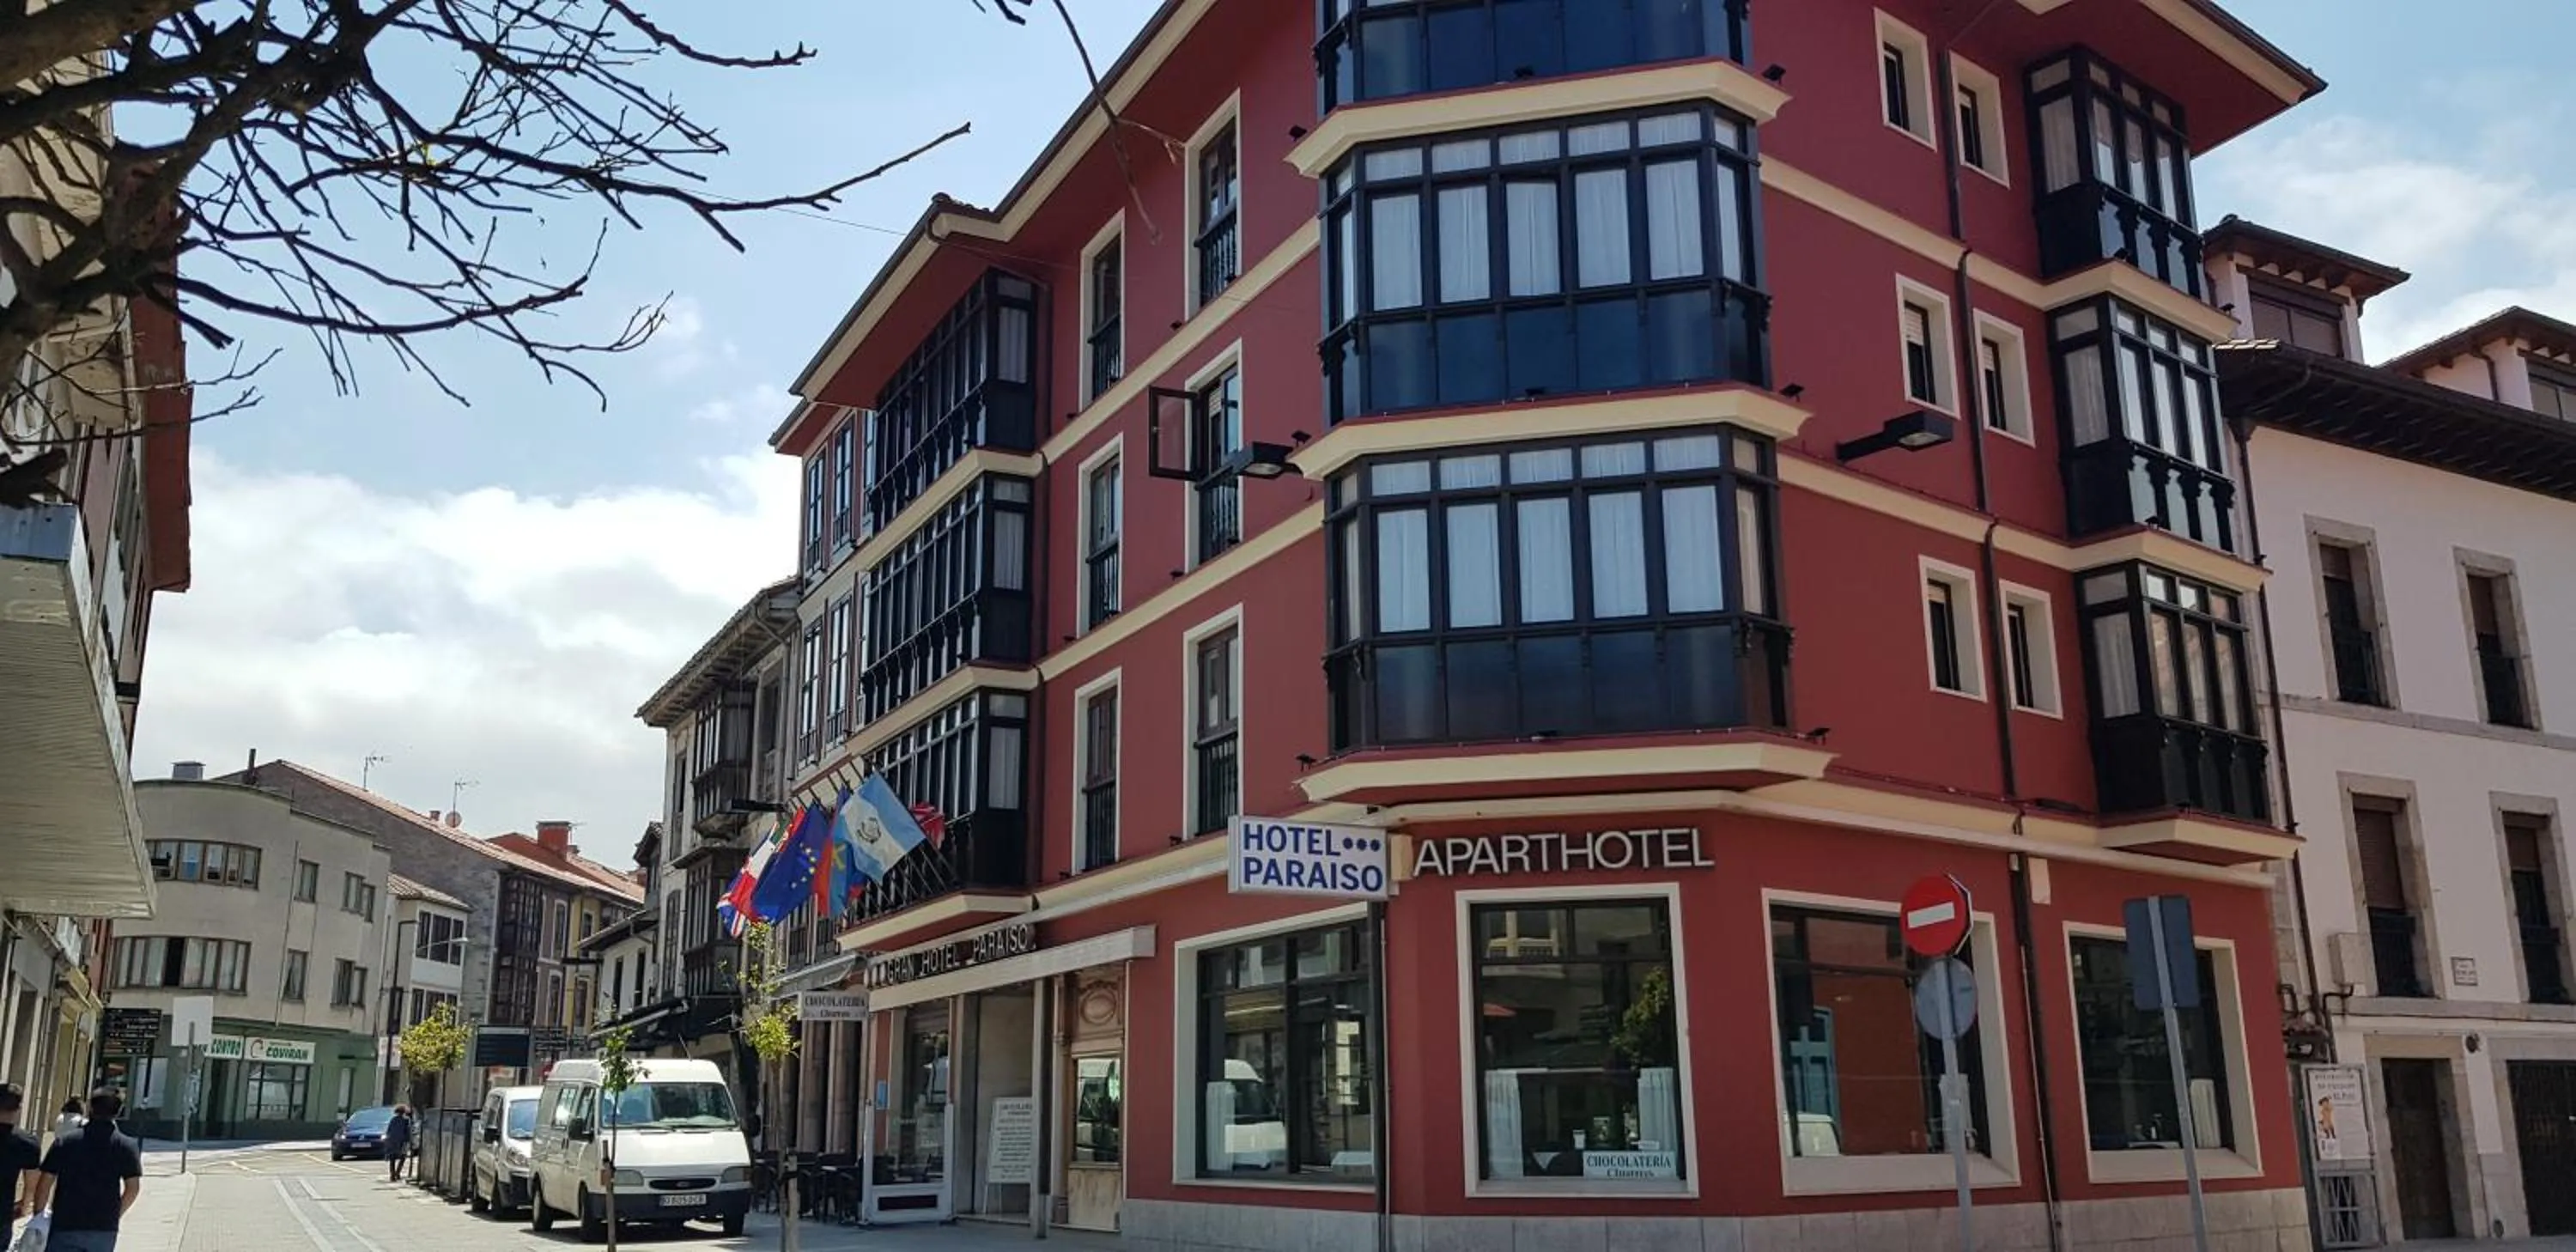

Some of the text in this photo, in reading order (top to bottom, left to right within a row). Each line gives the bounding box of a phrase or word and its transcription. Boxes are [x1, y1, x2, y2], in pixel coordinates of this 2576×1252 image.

[1243, 824, 1340, 856] HOTEL
[1413, 828, 1715, 877] APARTHOTEL
[1243, 857, 1382, 892] PARAISO
[886, 923, 1028, 985] GRAN HOTEL PARAISO
